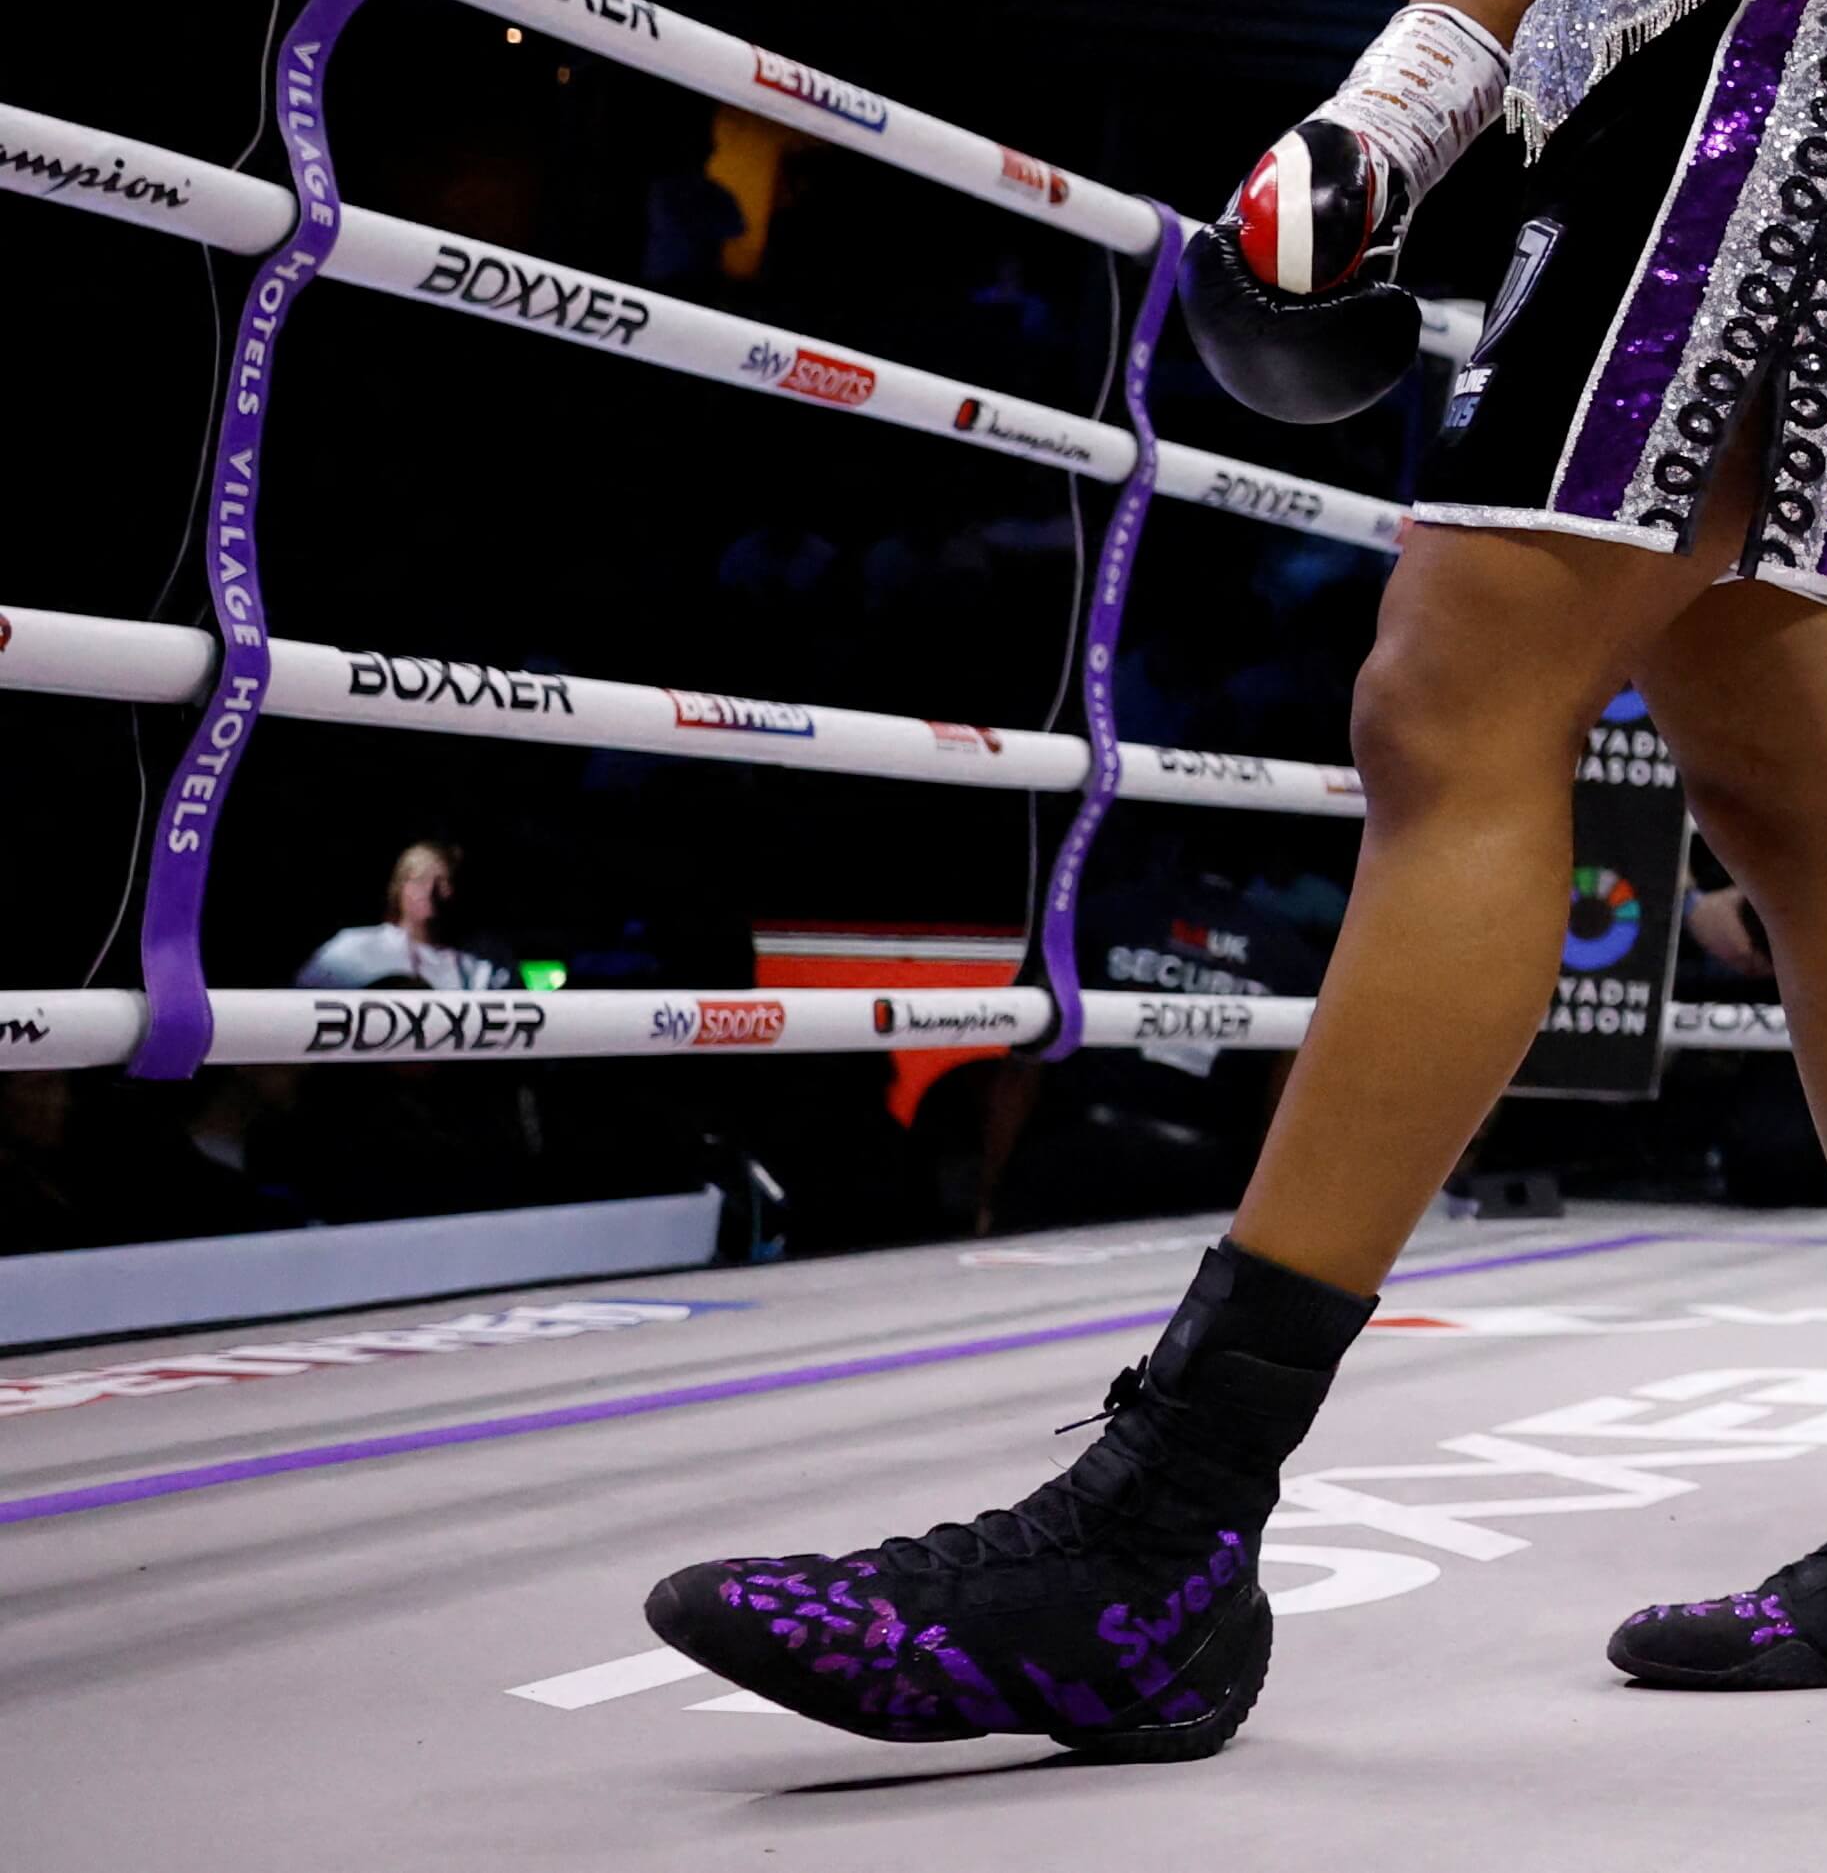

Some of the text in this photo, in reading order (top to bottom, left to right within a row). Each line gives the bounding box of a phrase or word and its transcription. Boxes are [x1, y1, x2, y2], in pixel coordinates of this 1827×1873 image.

[0, 144, 190, 208] mpion
[417, 244, 650, 346] BOXXER
[740, 340, 874, 406] sky sports
[168, 42, 335, 853] VILLAGE HOTELS VILLAGE HOTELS
[349, 650, 574, 715] BOXXER
[1587, 727, 1669, 760] YAD
[1575, 755, 1677, 788] ASON
[1558, 977, 1650, 1007] YADH
[305, 1000, 547, 1054] BOXXER
[650, 1005, 784, 1044] sky sports
[1540, 1005, 1647, 1036] ASON
